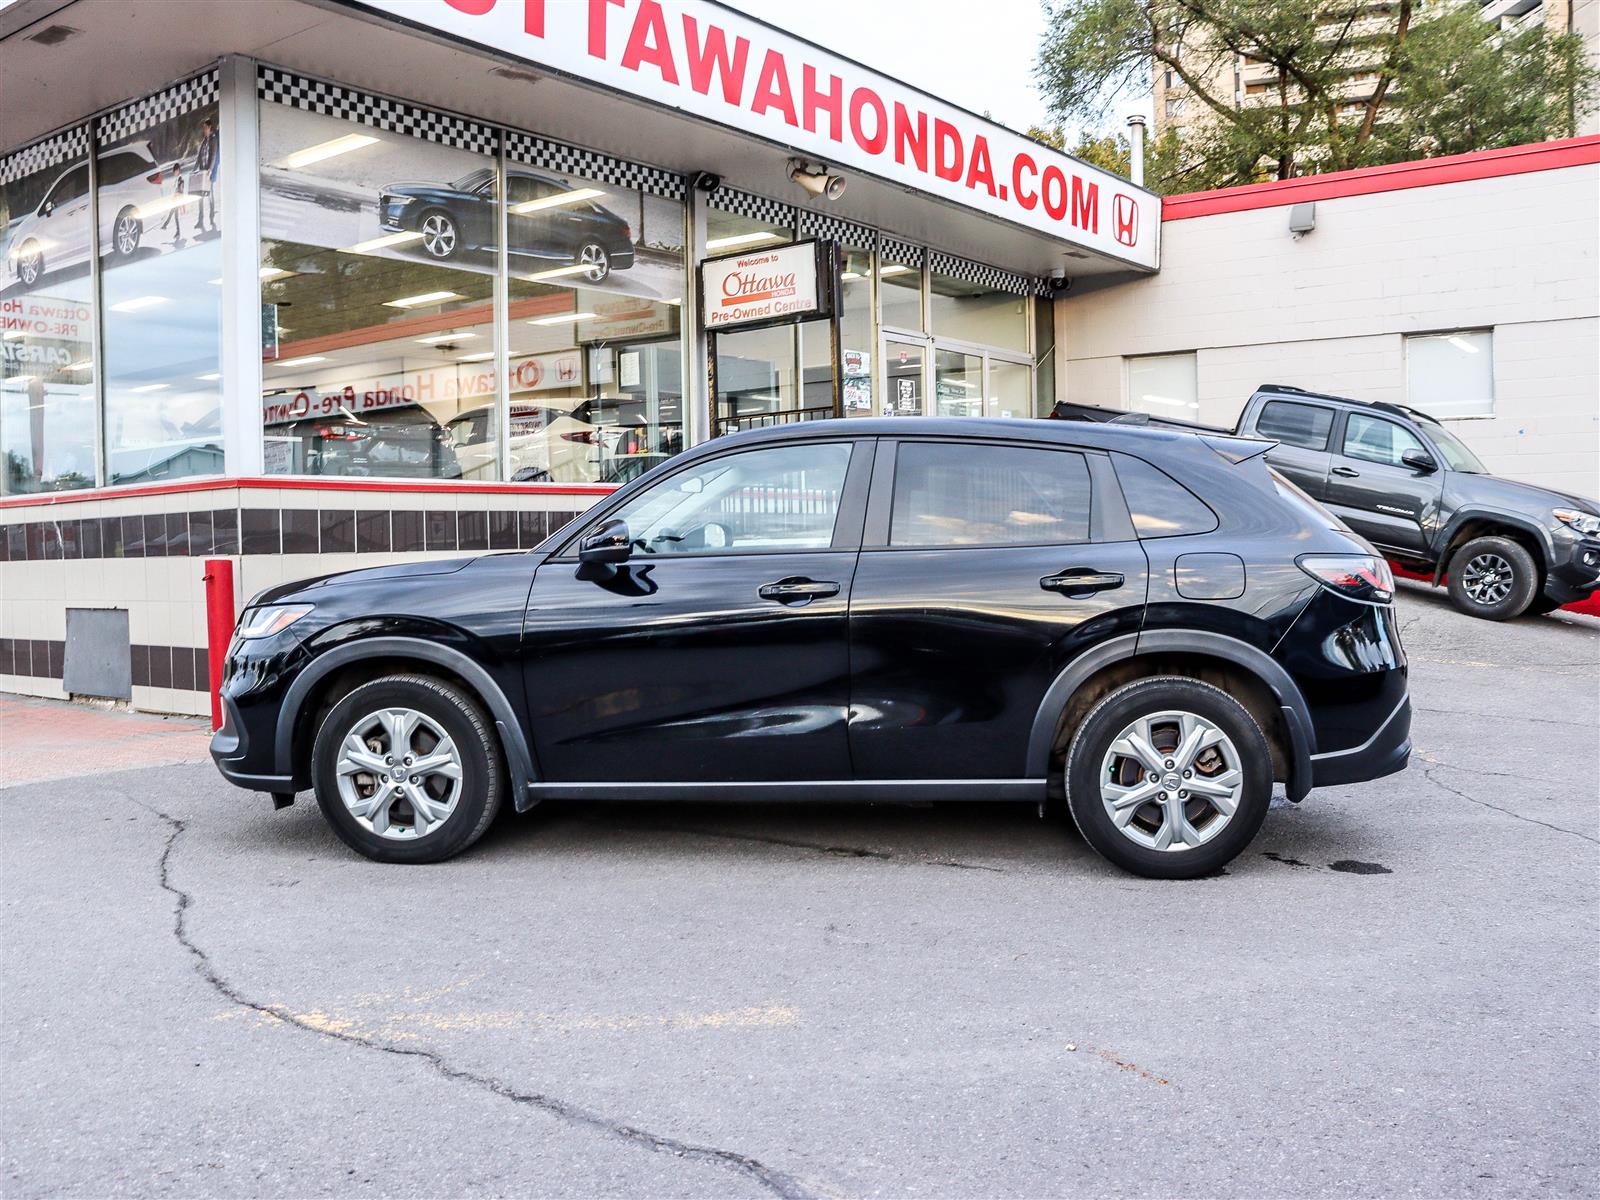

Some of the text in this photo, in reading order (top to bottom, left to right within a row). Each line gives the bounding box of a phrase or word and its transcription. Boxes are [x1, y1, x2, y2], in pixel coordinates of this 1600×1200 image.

[442, 0, 1099, 235] TAWAHONDA.COM
[736, 254, 779, 268] Welcome to
[722, 271, 796, 297] Ottawa
[771, 288, 795, 297] HONDA
[711, 299, 812, 323] Pre-Owned Centre
